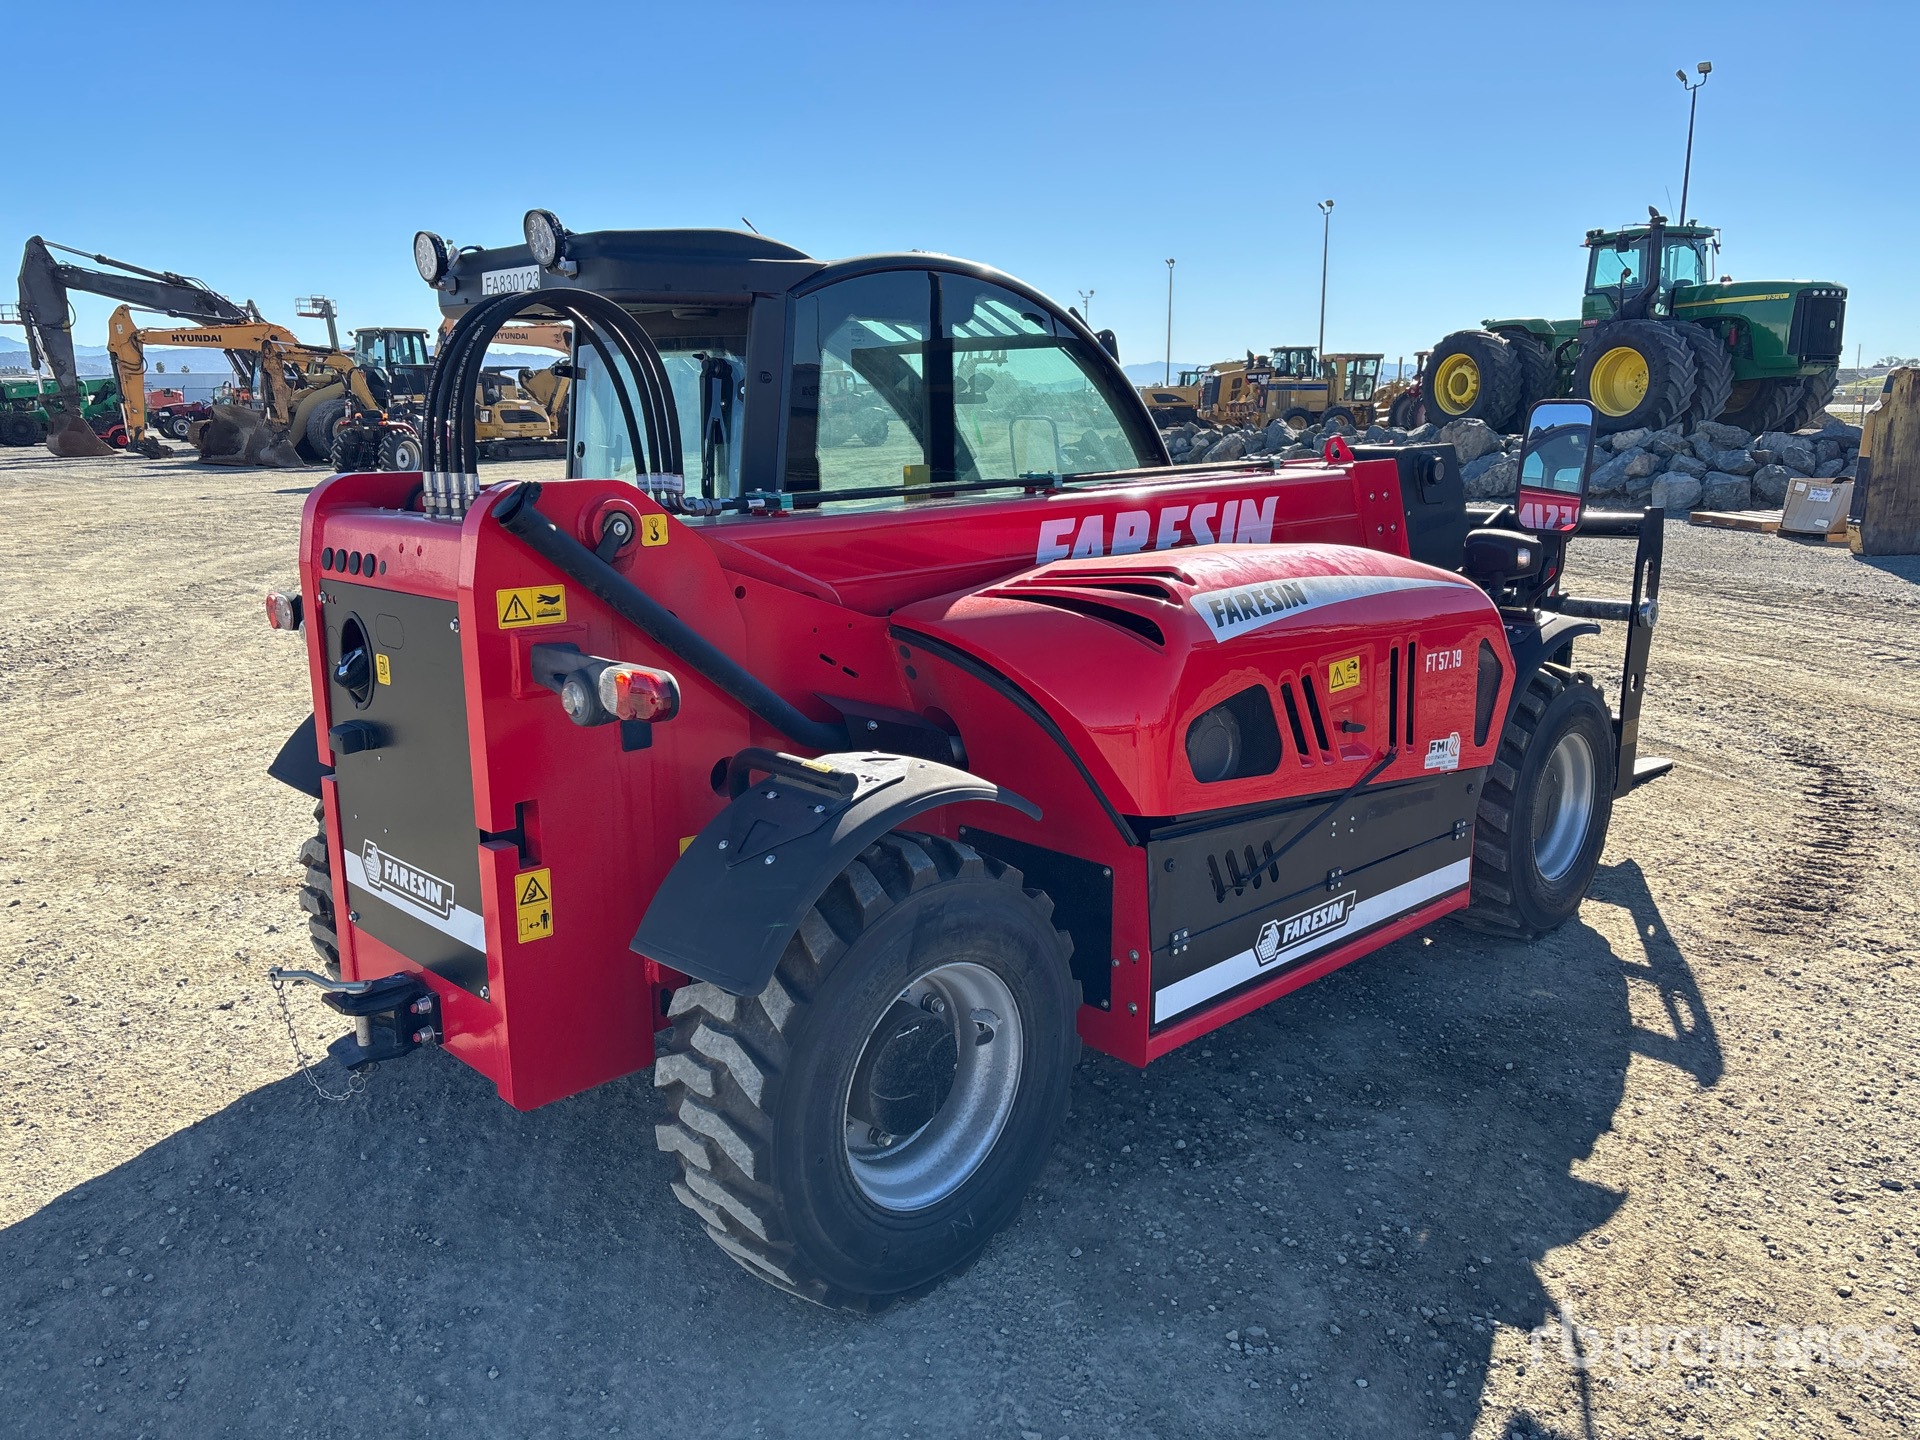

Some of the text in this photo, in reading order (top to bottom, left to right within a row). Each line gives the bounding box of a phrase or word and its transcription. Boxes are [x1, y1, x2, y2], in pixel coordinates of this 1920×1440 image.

[486, 271, 540, 295] FA830123
[171, 334, 223, 343] HYUNDAI
[444, 327, 458, 346] VOSS
[471, 323, 486, 341] VOSS
[1207, 581, 1309, 628] FARESIN
[1425, 649, 1462, 673] FT 57.19
[1429, 741, 1449, 754] FMI
[384, 860, 443, 906] FARESIN
[1283, 901, 1345, 943] FARESIN
